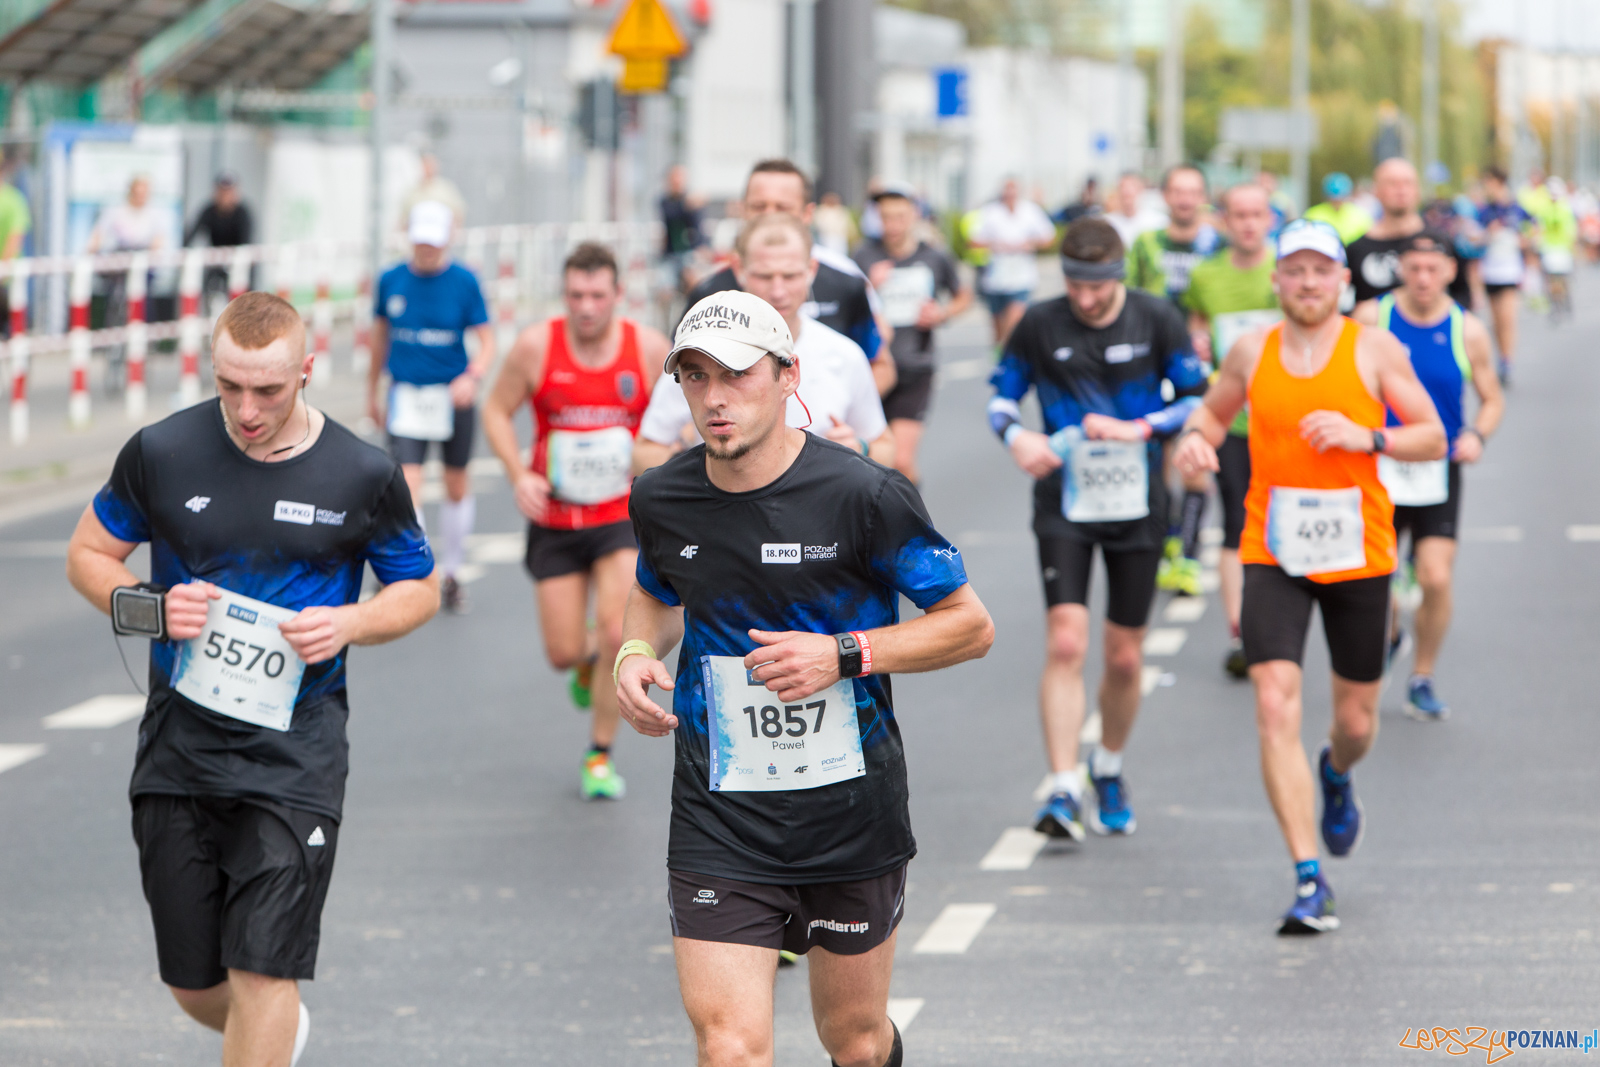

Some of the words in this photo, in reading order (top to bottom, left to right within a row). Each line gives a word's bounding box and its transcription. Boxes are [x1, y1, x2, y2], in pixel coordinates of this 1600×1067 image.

[681, 305, 750, 334] BROOKLYN
[690, 320, 732, 332] N.Y.C.
[185, 495, 211, 513] 4F
[291, 508, 311, 519] PKO
[1297, 519, 1344, 541] 493
[679, 545, 699, 560] 4F
[765, 549, 778, 558] 18.
[778, 549, 799, 558] PKO
[804, 552, 838, 560] maraton
[204, 630, 285, 679] 5570
[863, 648, 872, 662] AND
[219, 666, 258, 686] Krystian
[743, 699, 827, 738] 1857
[772, 740, 805, 750] Paweł
[793, 765, 808, 774] 4F
[692, 897, 719, 906] Kalenji
[807, 919, 870, 940] enderup
